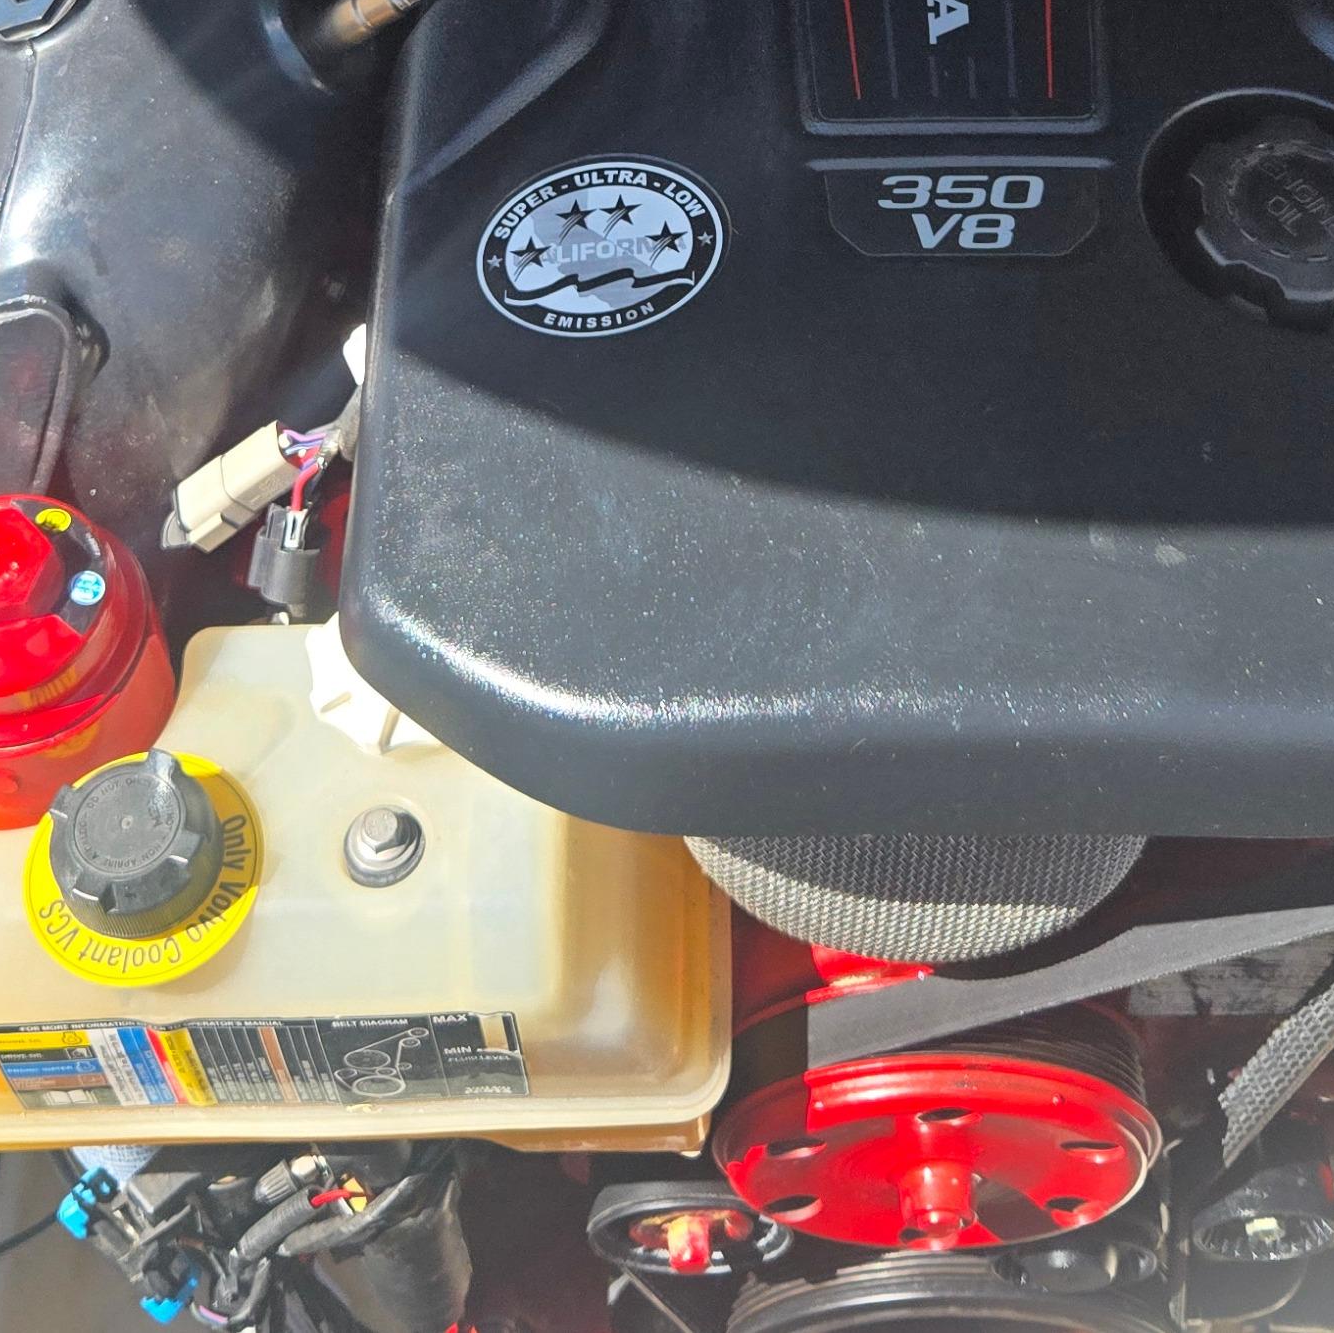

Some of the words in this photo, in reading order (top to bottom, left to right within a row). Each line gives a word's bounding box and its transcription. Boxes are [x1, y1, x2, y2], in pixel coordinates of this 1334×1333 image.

[493, 185, 558, 240] SUPER
[574, 169, 648, 187] ULTRA
[662, 181, 706, 218] LOW
[877, 174, 1045, 209] 350
[911, 213, 1016, 249] V8
[1267, 195, 1302, 237] OIL
[543, 301, 656, 329] EMISSION
[222, 813, 252, 872] Only
[39, 899, 80, 952] VCS
[185, 880, 247, 944] Volvo
[77, 937, 181, 974] Coolant
[41, 1023, 68, 1031] MORE
[331, 1020, 357, 1028] BELT
[359, 1018, 408, 1027] DIAGRAM
[433, 1013, 468, 1024] MAX
[443, 1045, 472, 1055] MIN
